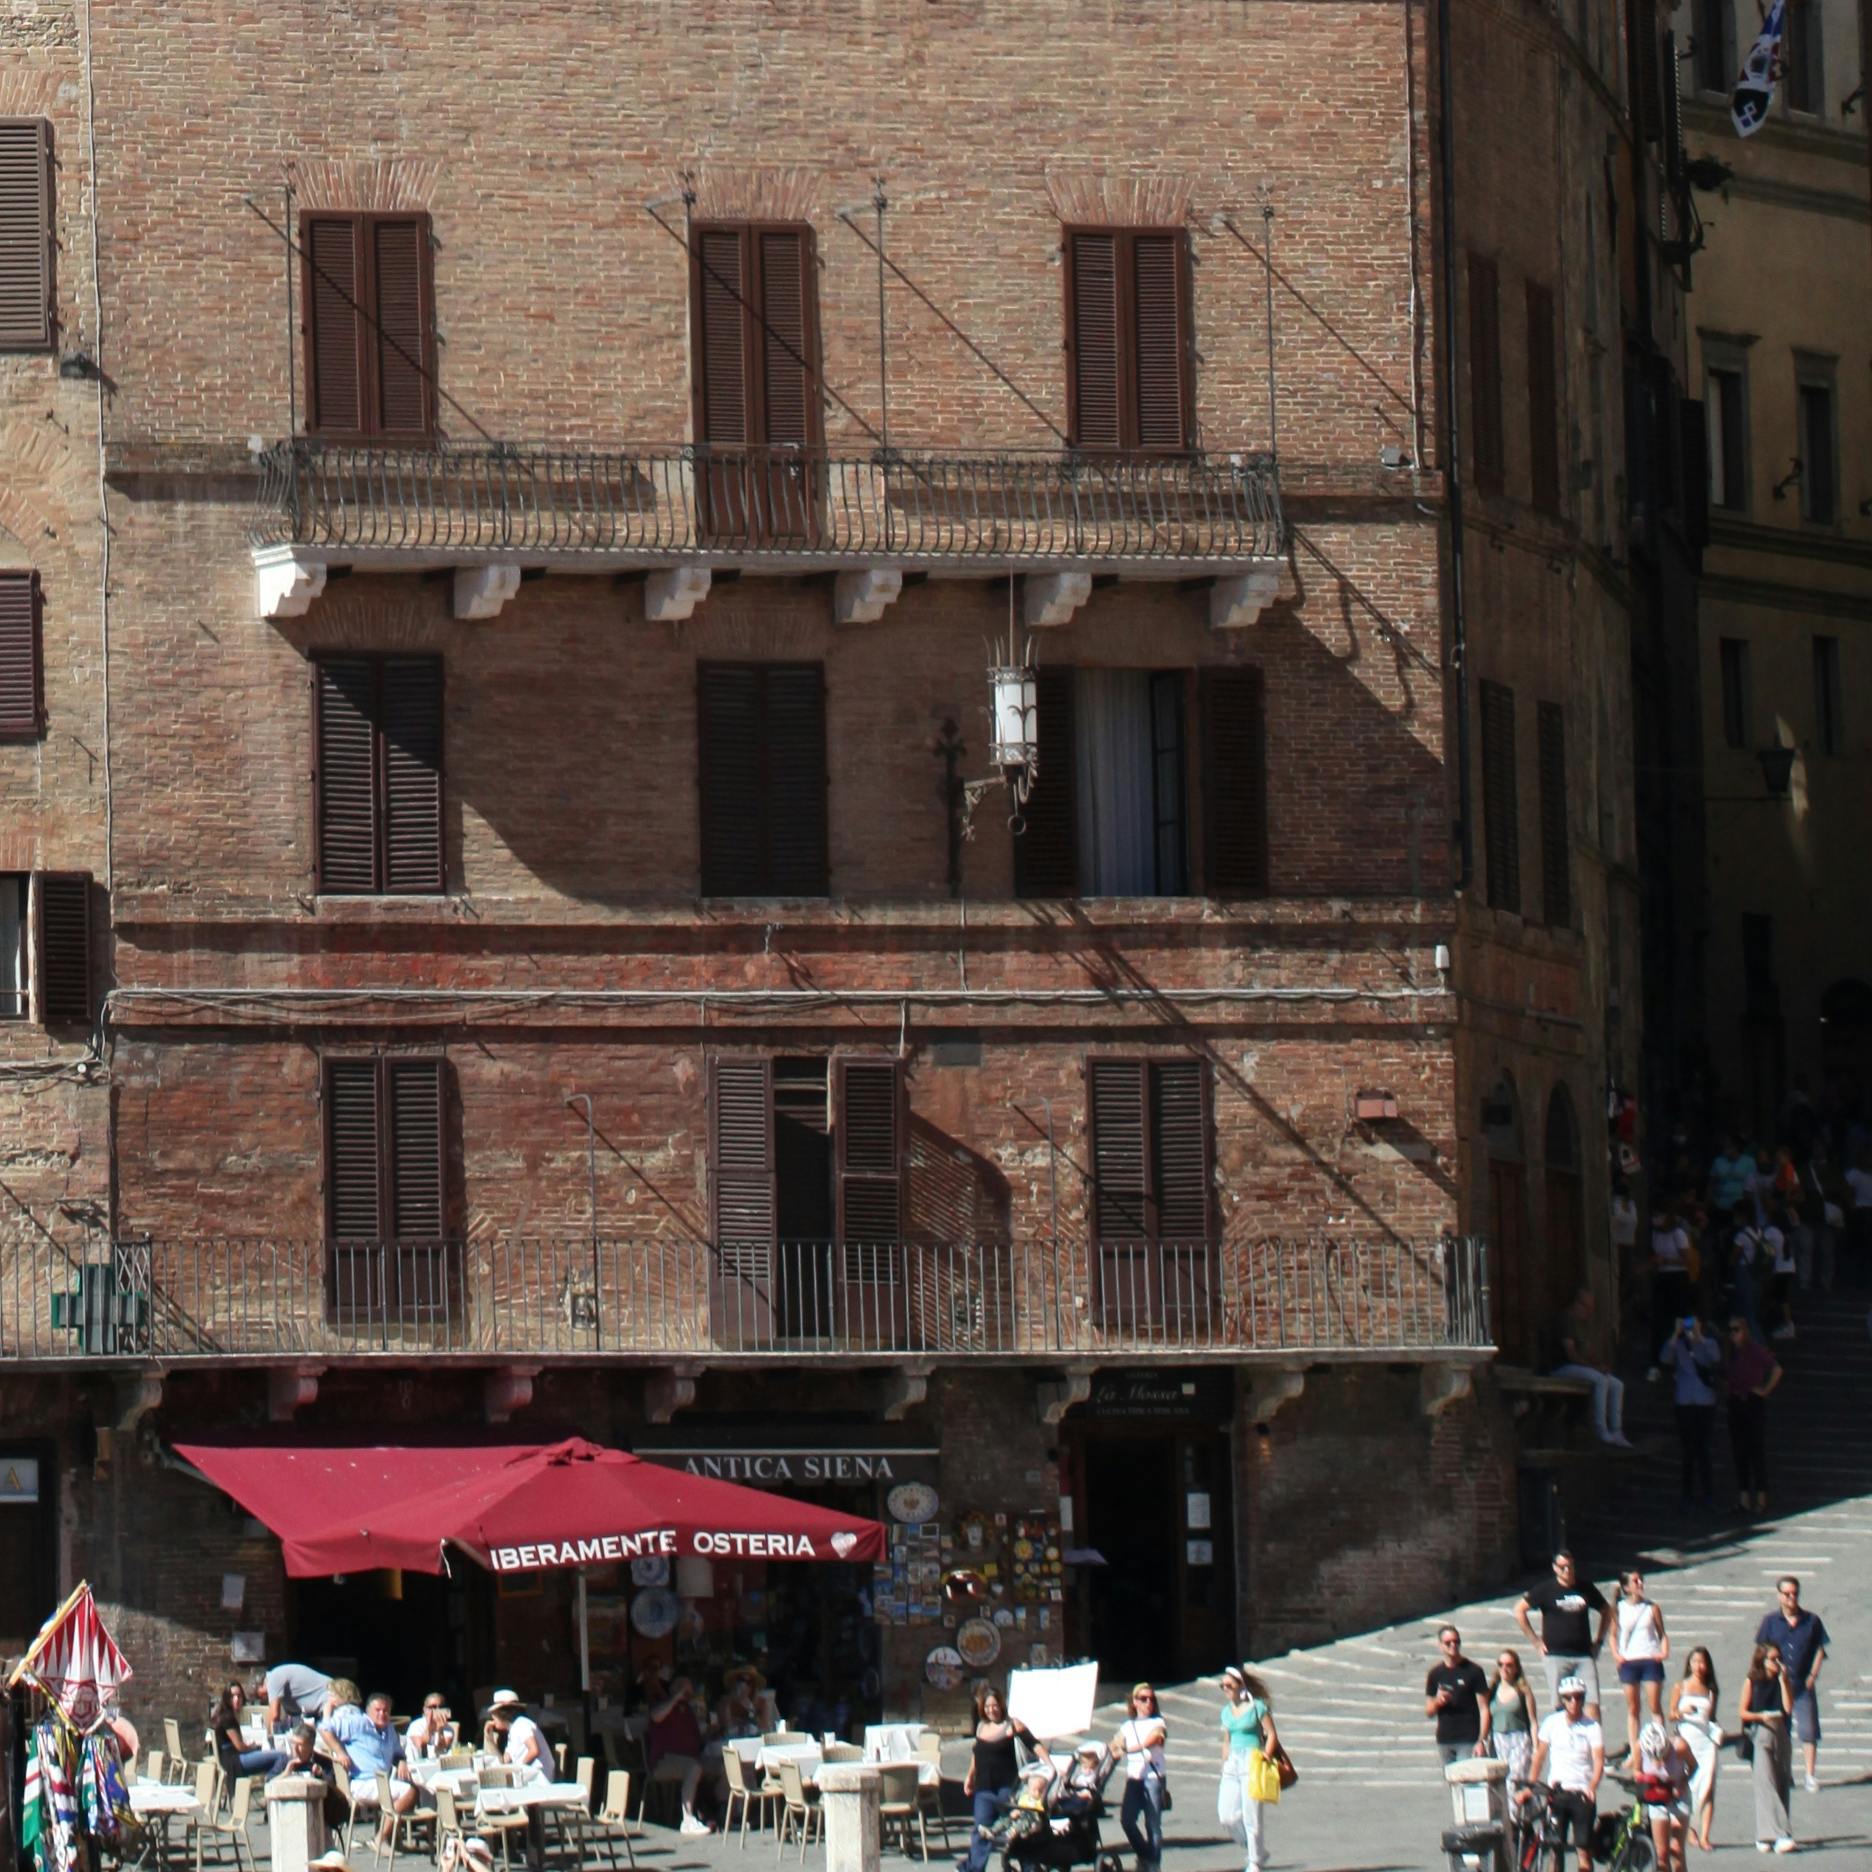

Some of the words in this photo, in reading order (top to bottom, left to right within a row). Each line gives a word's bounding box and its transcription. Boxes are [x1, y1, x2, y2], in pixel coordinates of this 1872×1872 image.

[684, 1456, 793, 1479] ANTICA
[804, 1456, 895, 1479] SIENA
[693, 1531, 816, 1556] OSTERIA
